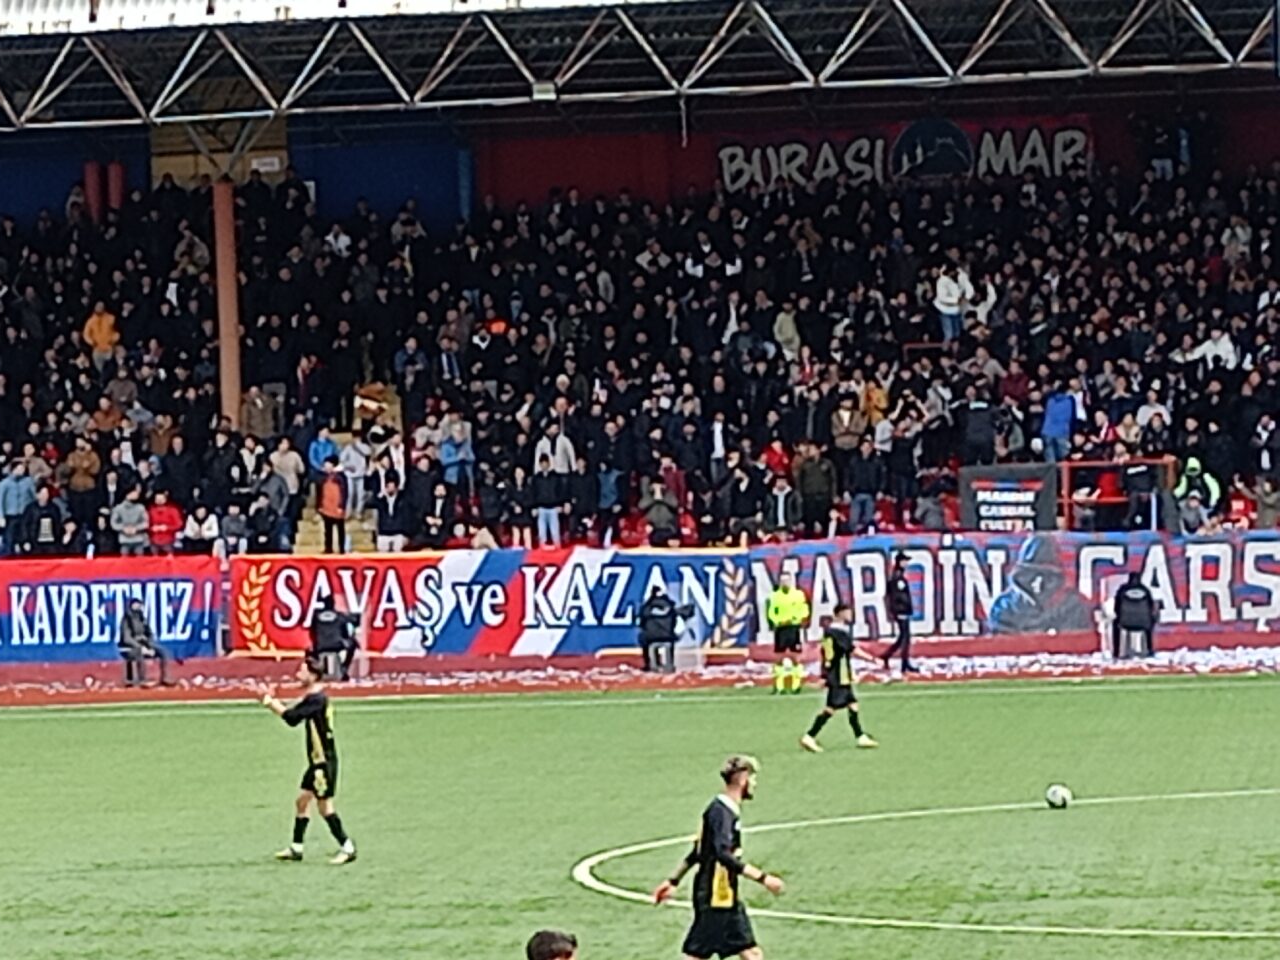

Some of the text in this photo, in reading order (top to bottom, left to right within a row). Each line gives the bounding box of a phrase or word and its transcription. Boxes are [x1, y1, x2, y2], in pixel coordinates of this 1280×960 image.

[718, 137, 885, 194] BURASI
[273, 567, 444, 646] SAVAŞ
[453, 584, 506, 627] ve
